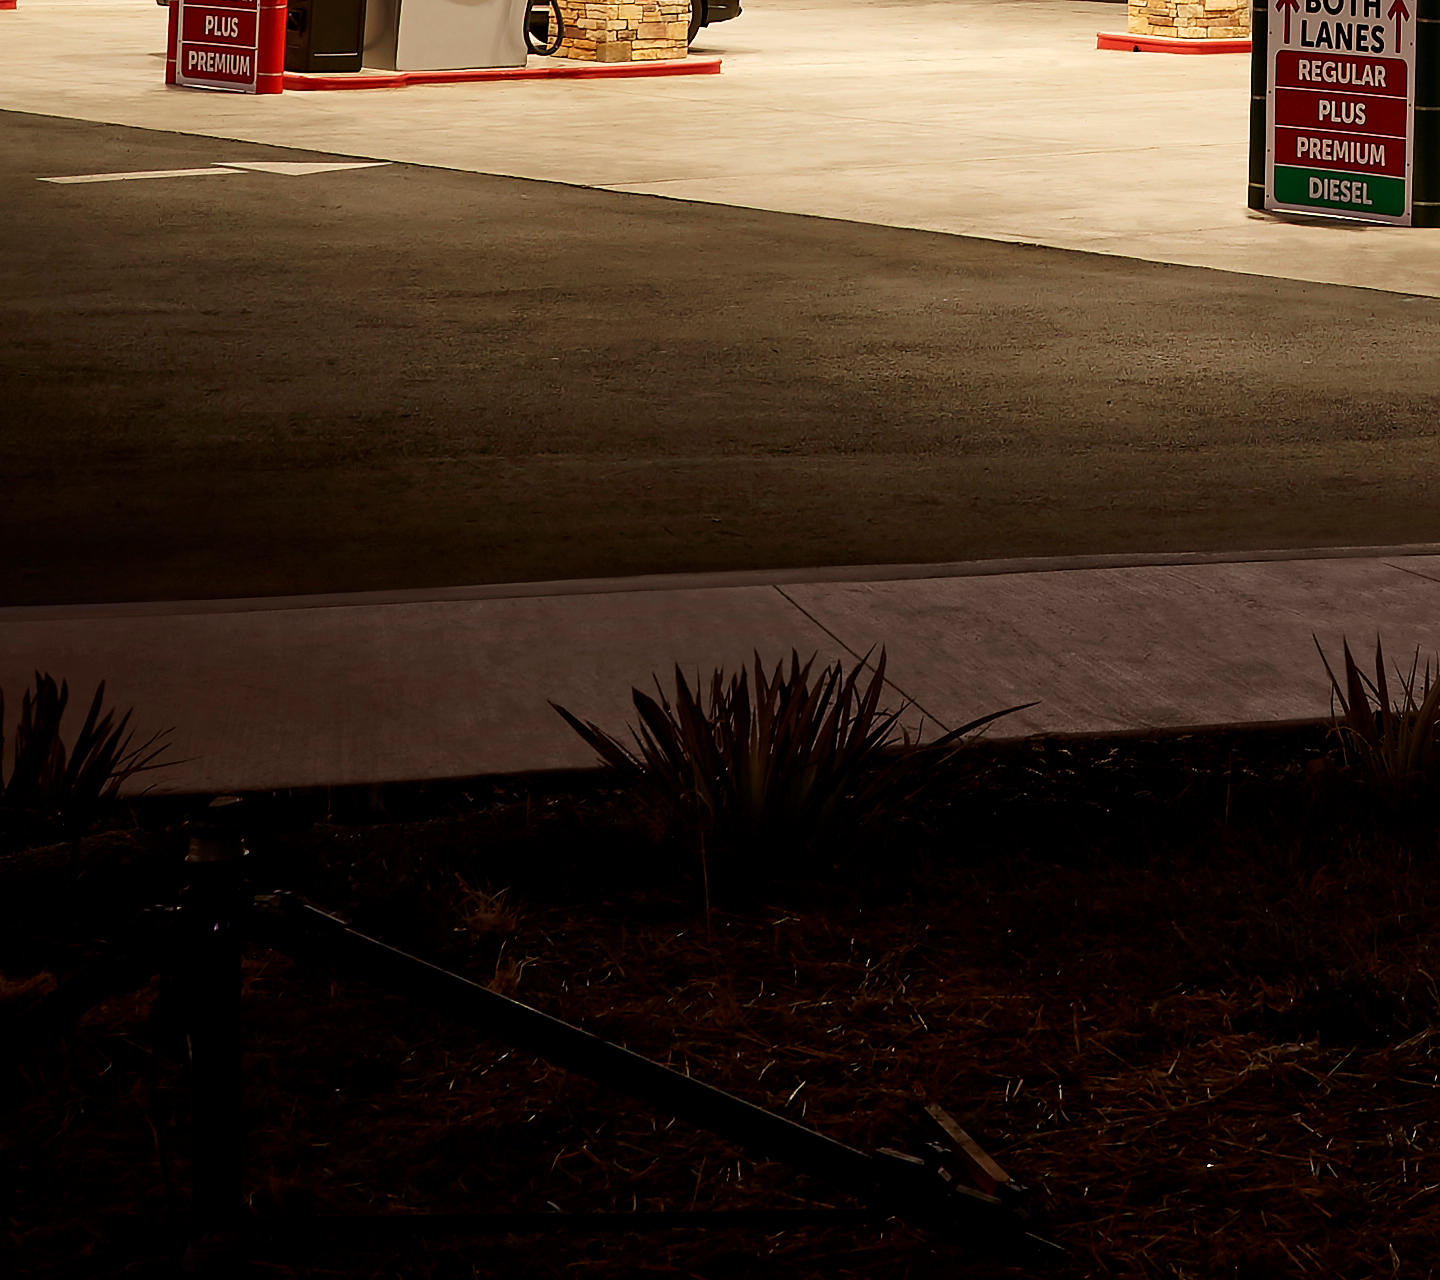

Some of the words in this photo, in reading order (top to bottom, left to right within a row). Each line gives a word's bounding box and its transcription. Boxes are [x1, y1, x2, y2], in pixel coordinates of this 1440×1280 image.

[205, 15, 239, 38] PLUS
[1300, 19, 1385, 53] LANES
[188, 50, 250, 77] PREMIUM
[1298, 59, 1386, 88] REGULAR
[1318, 99, 1366, 124] PLUS
[1296, 136, 1386, 167] PREMIUM
[1308, 177, 1372, 205] DIESEL
